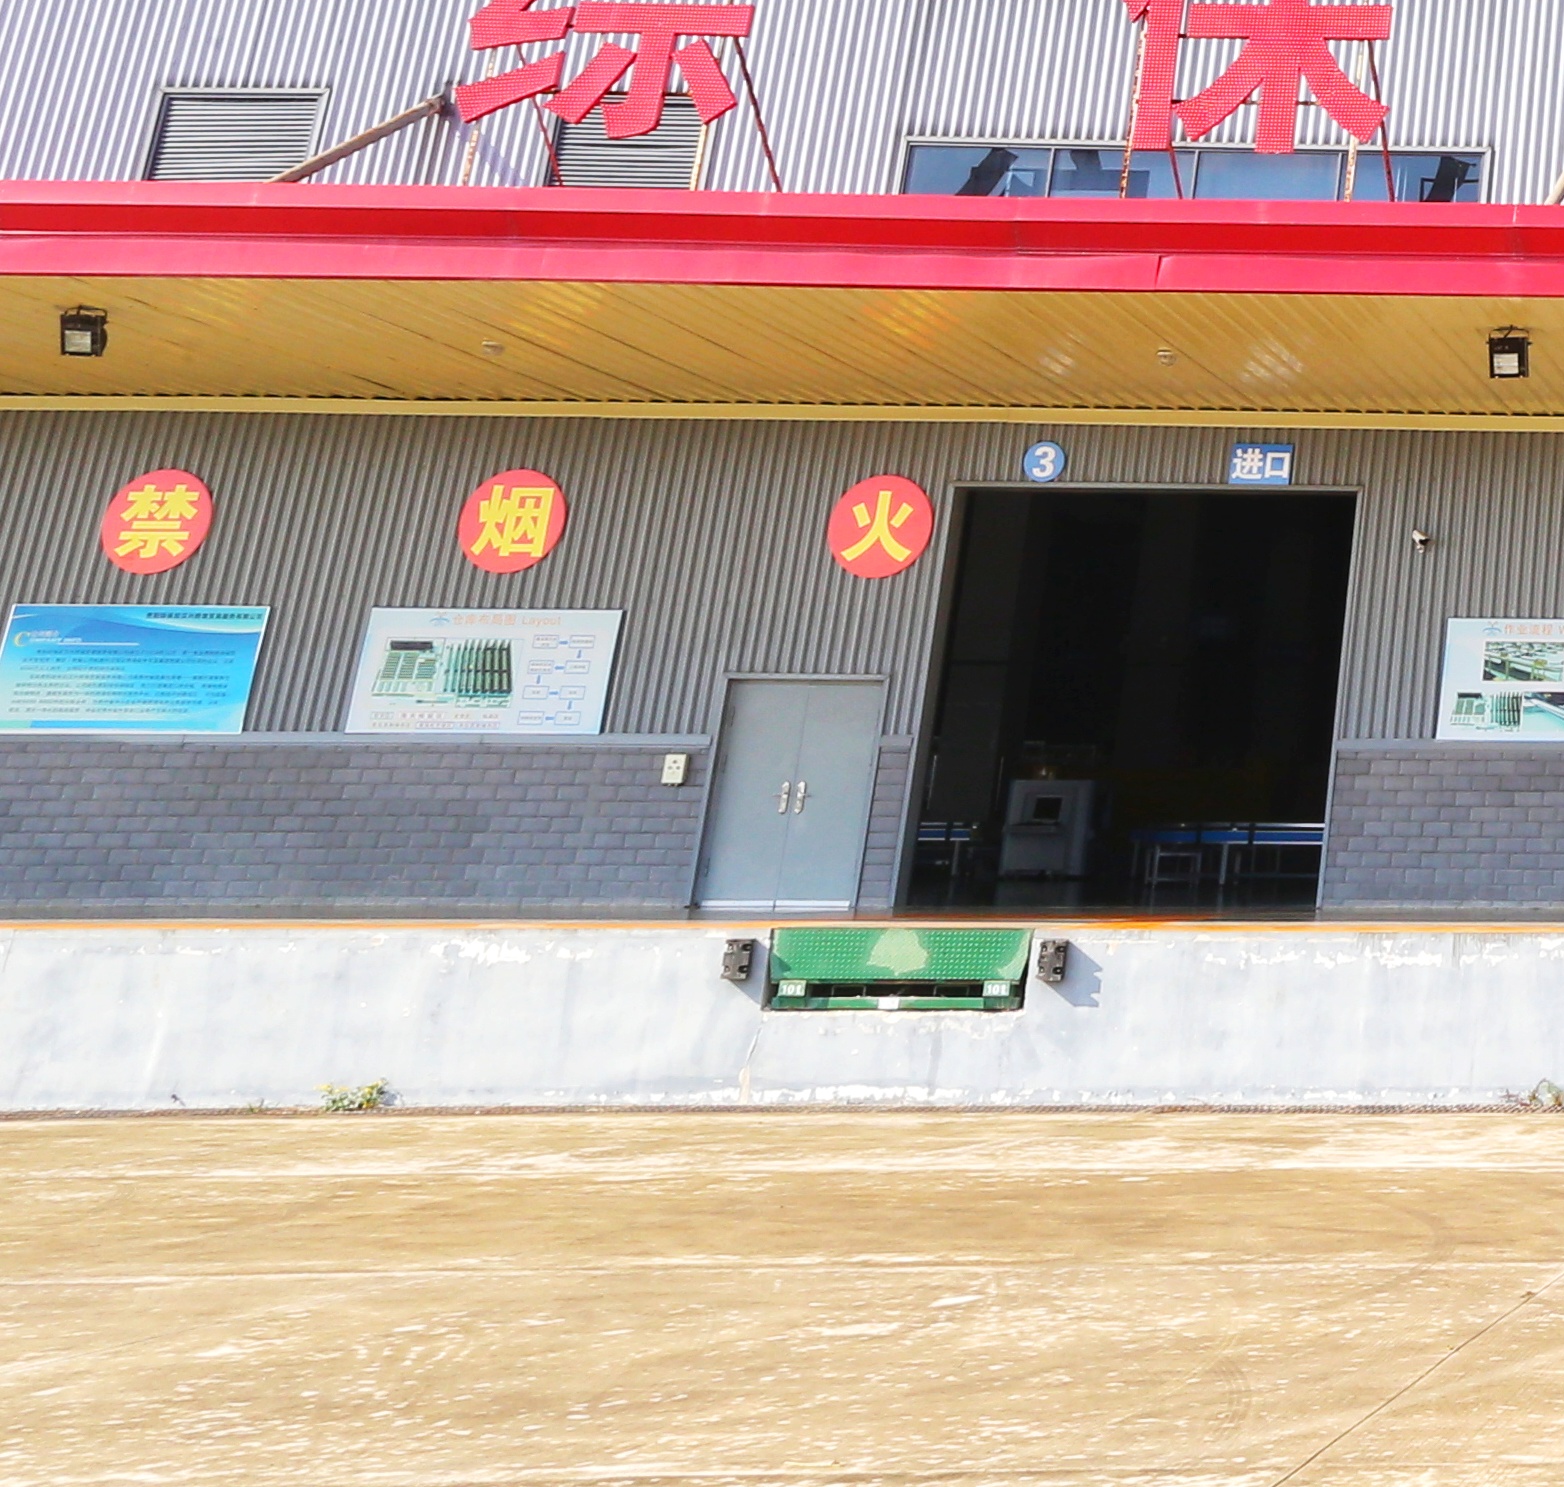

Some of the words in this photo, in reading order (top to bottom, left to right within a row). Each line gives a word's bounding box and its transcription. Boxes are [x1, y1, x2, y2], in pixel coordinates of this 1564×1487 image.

[1031, 445, 1057, 479] 3
[1231, 448, 1291, 481] 进口
[116, 484, 198, 559] 禁
[471, 485, 556, 558] 烟
[840, 491, 913, 564] 火
[522, 615, 562, 627] Layout
[1504, 623, 1554, 636] 作业流程
